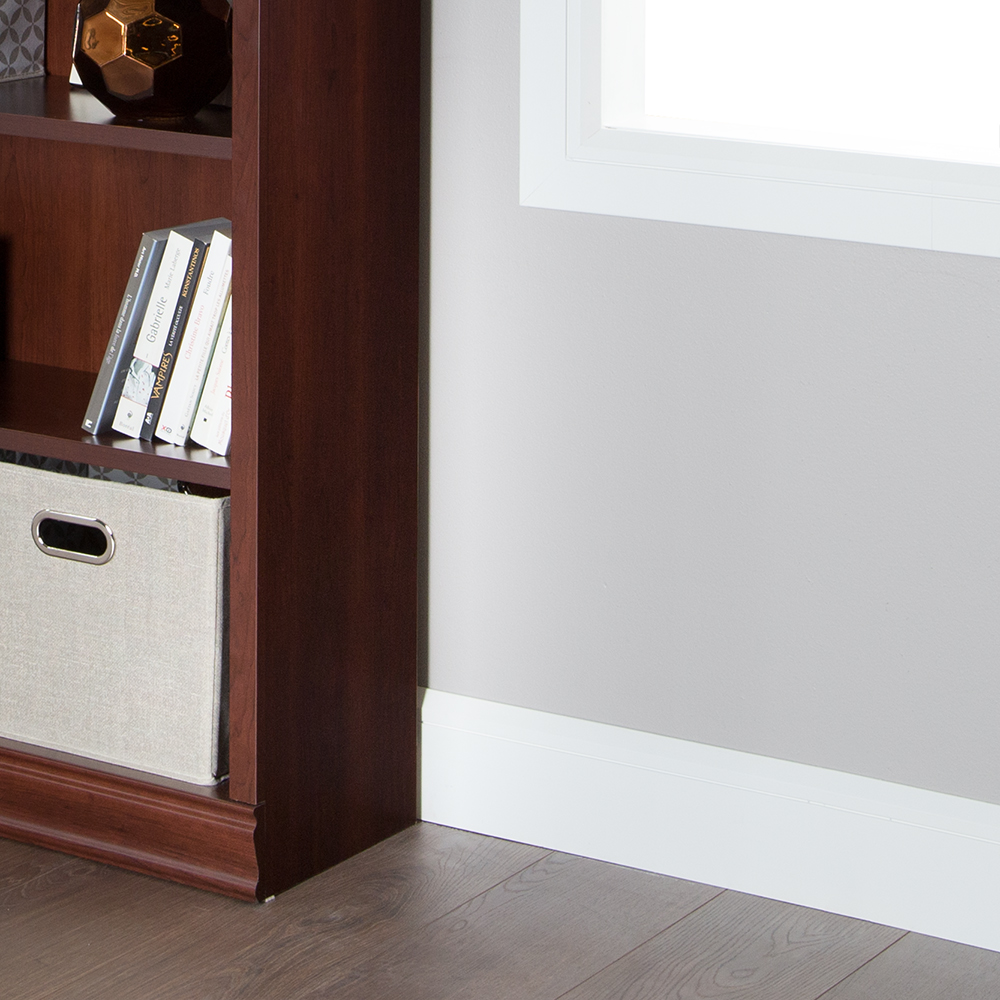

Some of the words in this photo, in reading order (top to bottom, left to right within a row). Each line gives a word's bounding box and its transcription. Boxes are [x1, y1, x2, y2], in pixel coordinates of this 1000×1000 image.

[163, 272, 174, 290] Marie
[169, 247, 181, 272] Laberge
[181, 247, 200, 298] KONSTANTINOS
[202, 270, 216, 295] Foudre
[145, 296, 168, 343] Gabrielle
[183, 326, 200, 360] Christine
[193, 304, 206, 325] Bravo
[151, 351, 174, 399] VAMPIRES
